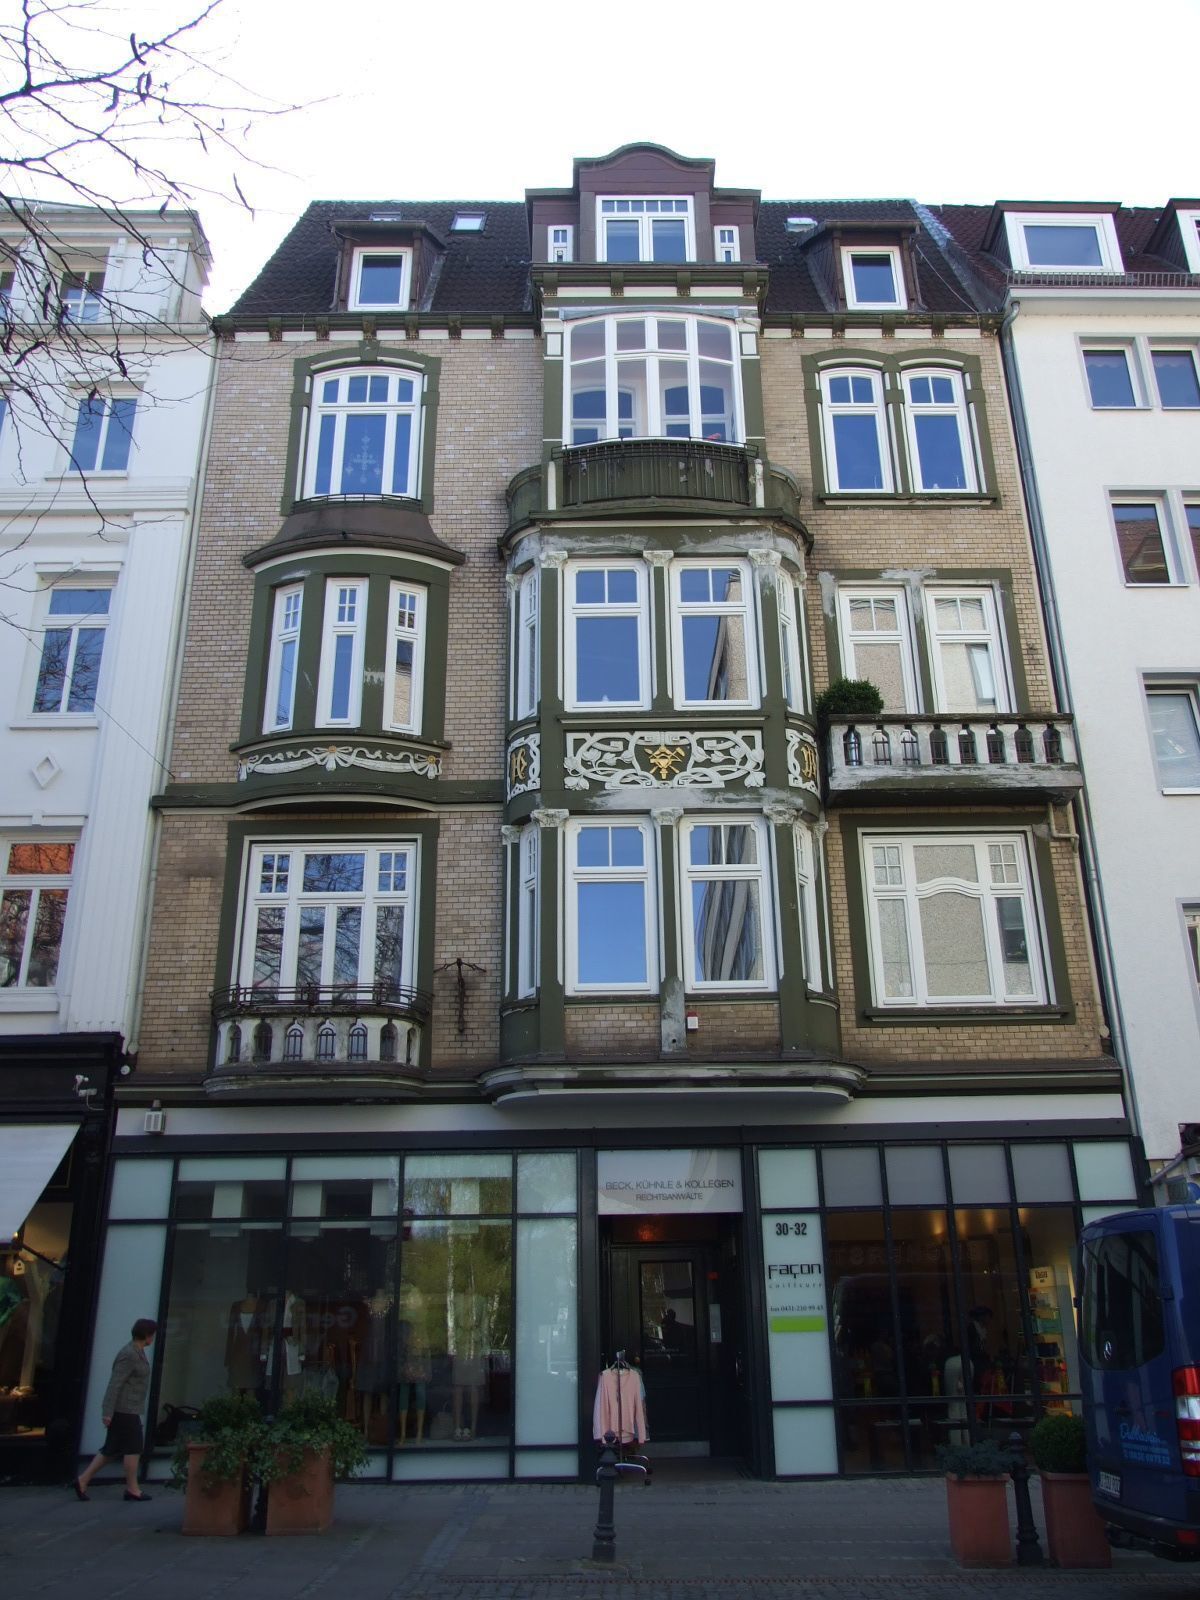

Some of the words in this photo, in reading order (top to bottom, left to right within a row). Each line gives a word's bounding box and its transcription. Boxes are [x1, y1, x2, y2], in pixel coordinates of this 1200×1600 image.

[606, 1182, 634, 1191] BECK,
[636, 1180, 674, 1190] KÜHNLE
[675, 1181, 683, 1189] &
[684, 1179, 735, 1189] KOLLEGEN
[635, 1192, 704, 1201] RECHTSANWÄLTE
[776, 1222, 807, 1236] 30-32
[768, 1263, 822, 1280] Façon
